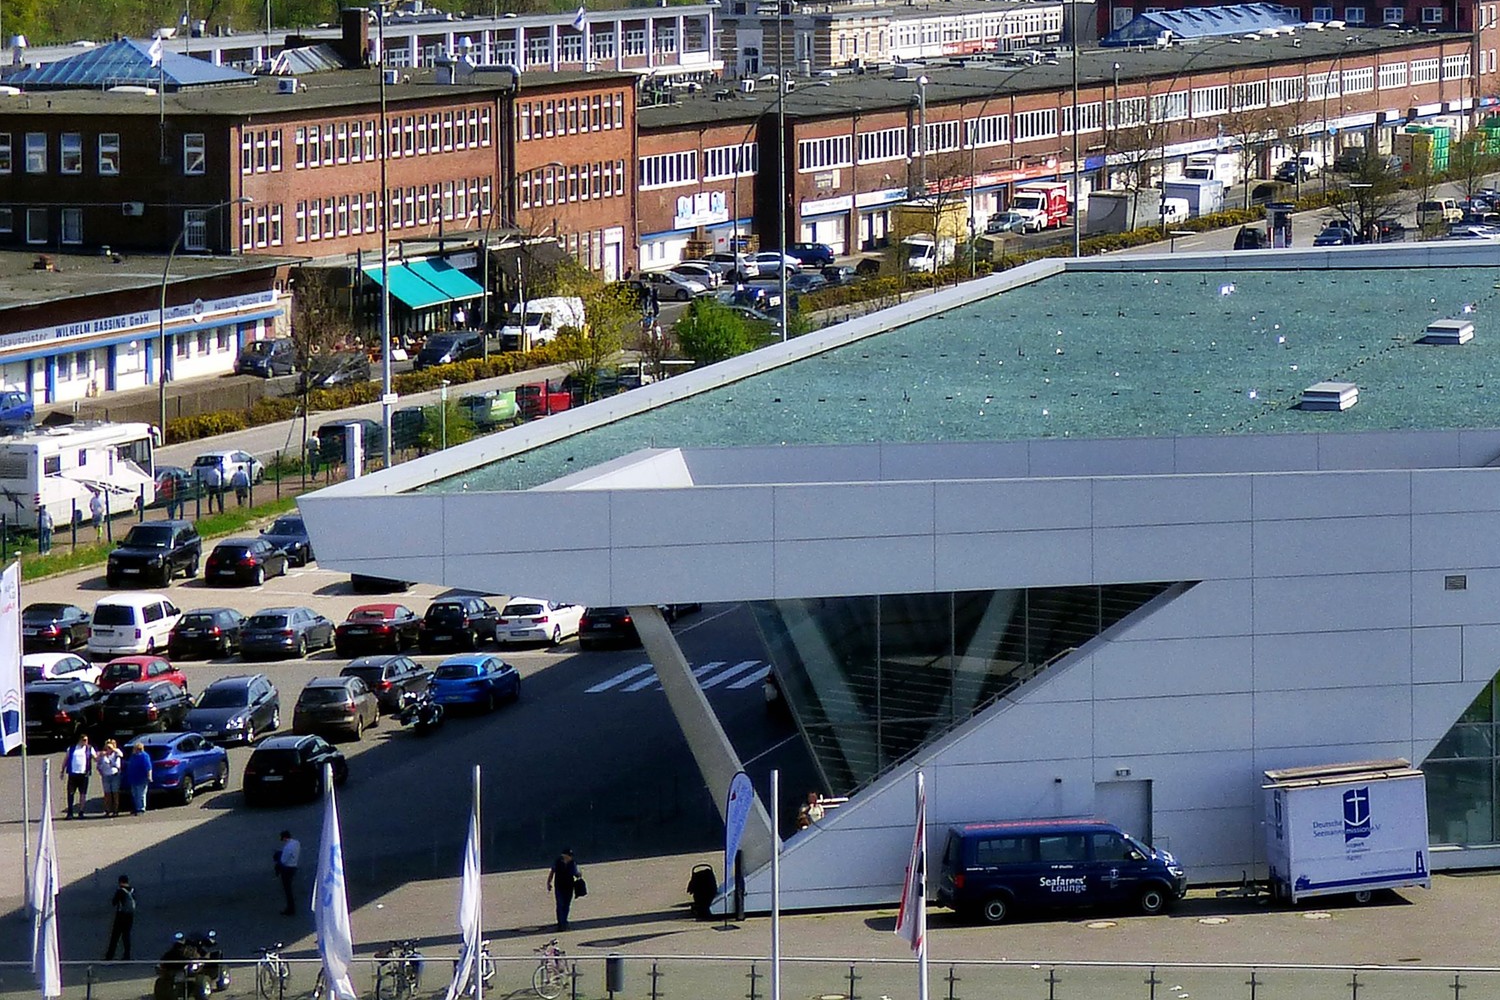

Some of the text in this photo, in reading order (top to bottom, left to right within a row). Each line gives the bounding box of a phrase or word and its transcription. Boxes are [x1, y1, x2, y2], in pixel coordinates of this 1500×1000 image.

[55, 324, 91, 338] WILHELM
[94, 317, 126, 332] BASSING
[129, 313, 149, 326] GmbH
[1051, 884, 1087, 894] Lounge
